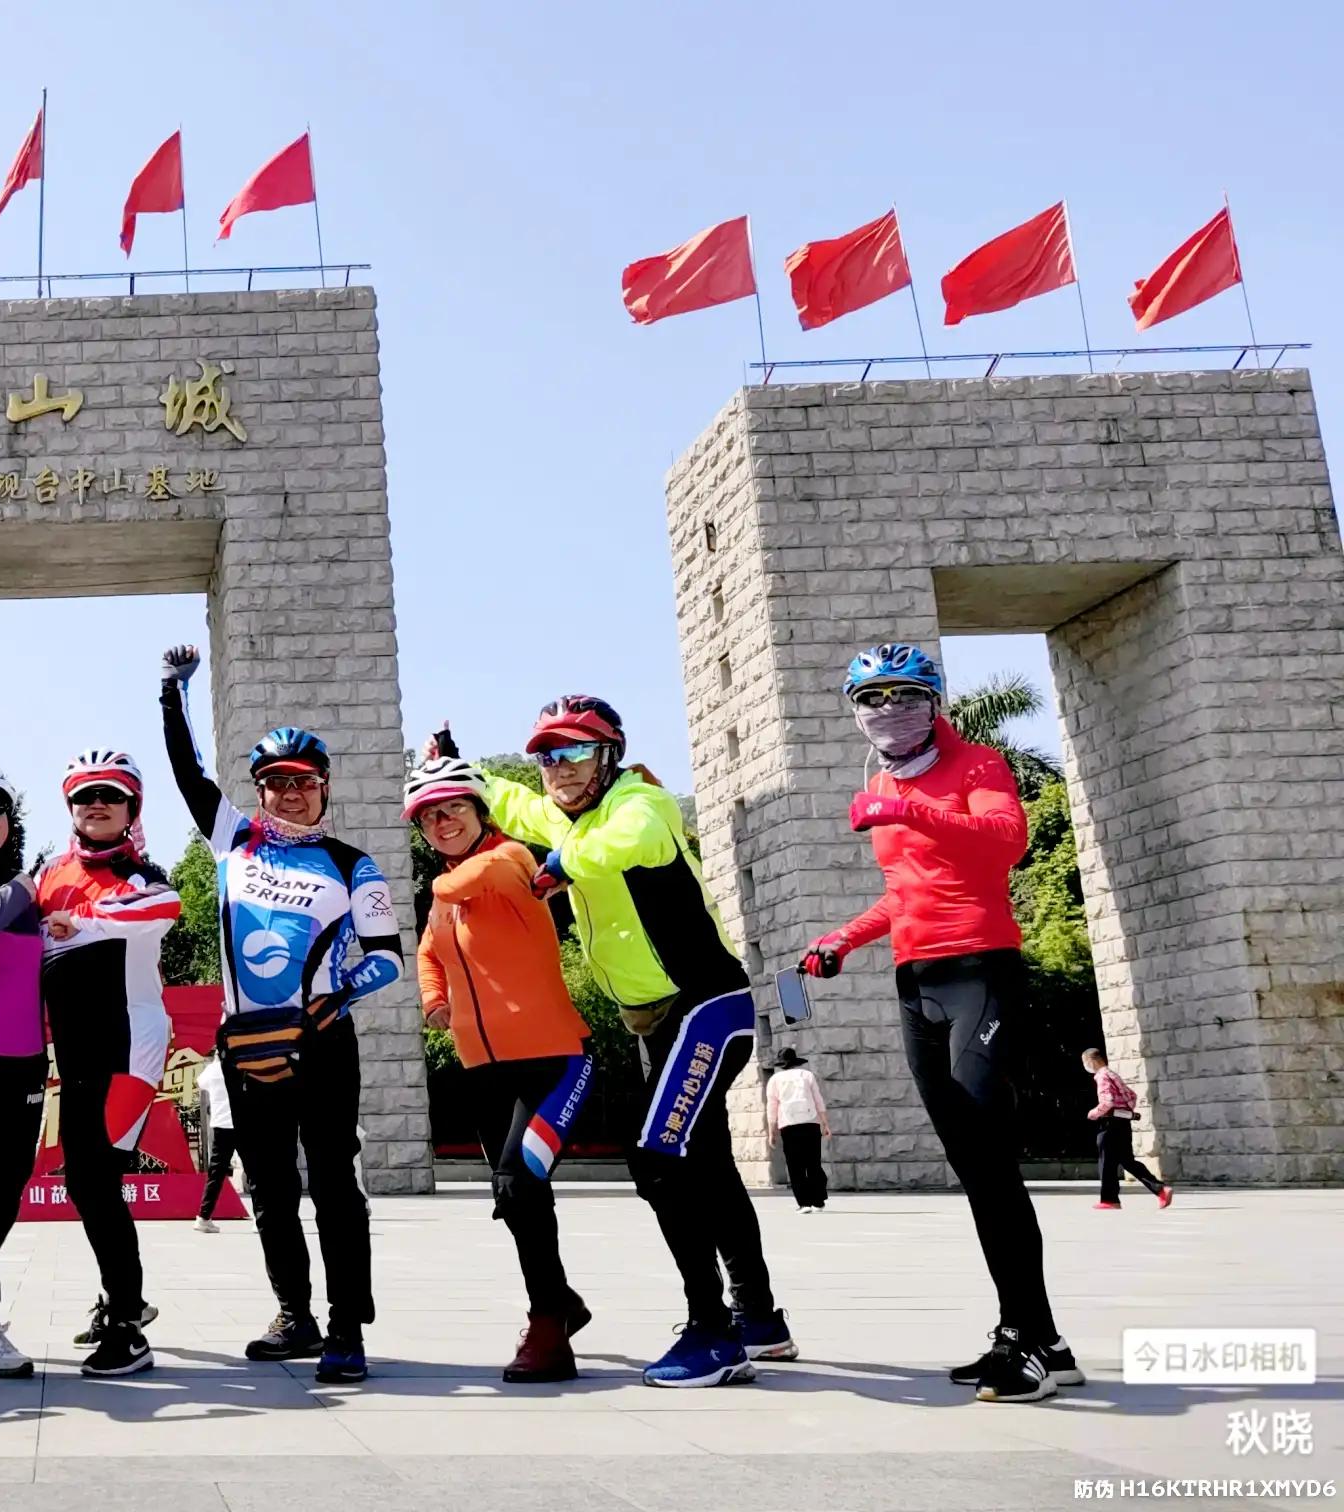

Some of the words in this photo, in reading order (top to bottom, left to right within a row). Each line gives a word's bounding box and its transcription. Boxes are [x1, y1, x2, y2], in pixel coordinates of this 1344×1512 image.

[243, 882, 314, 908] SRAM
[659, 1041, 714, 1144] 合肥开心骑游
